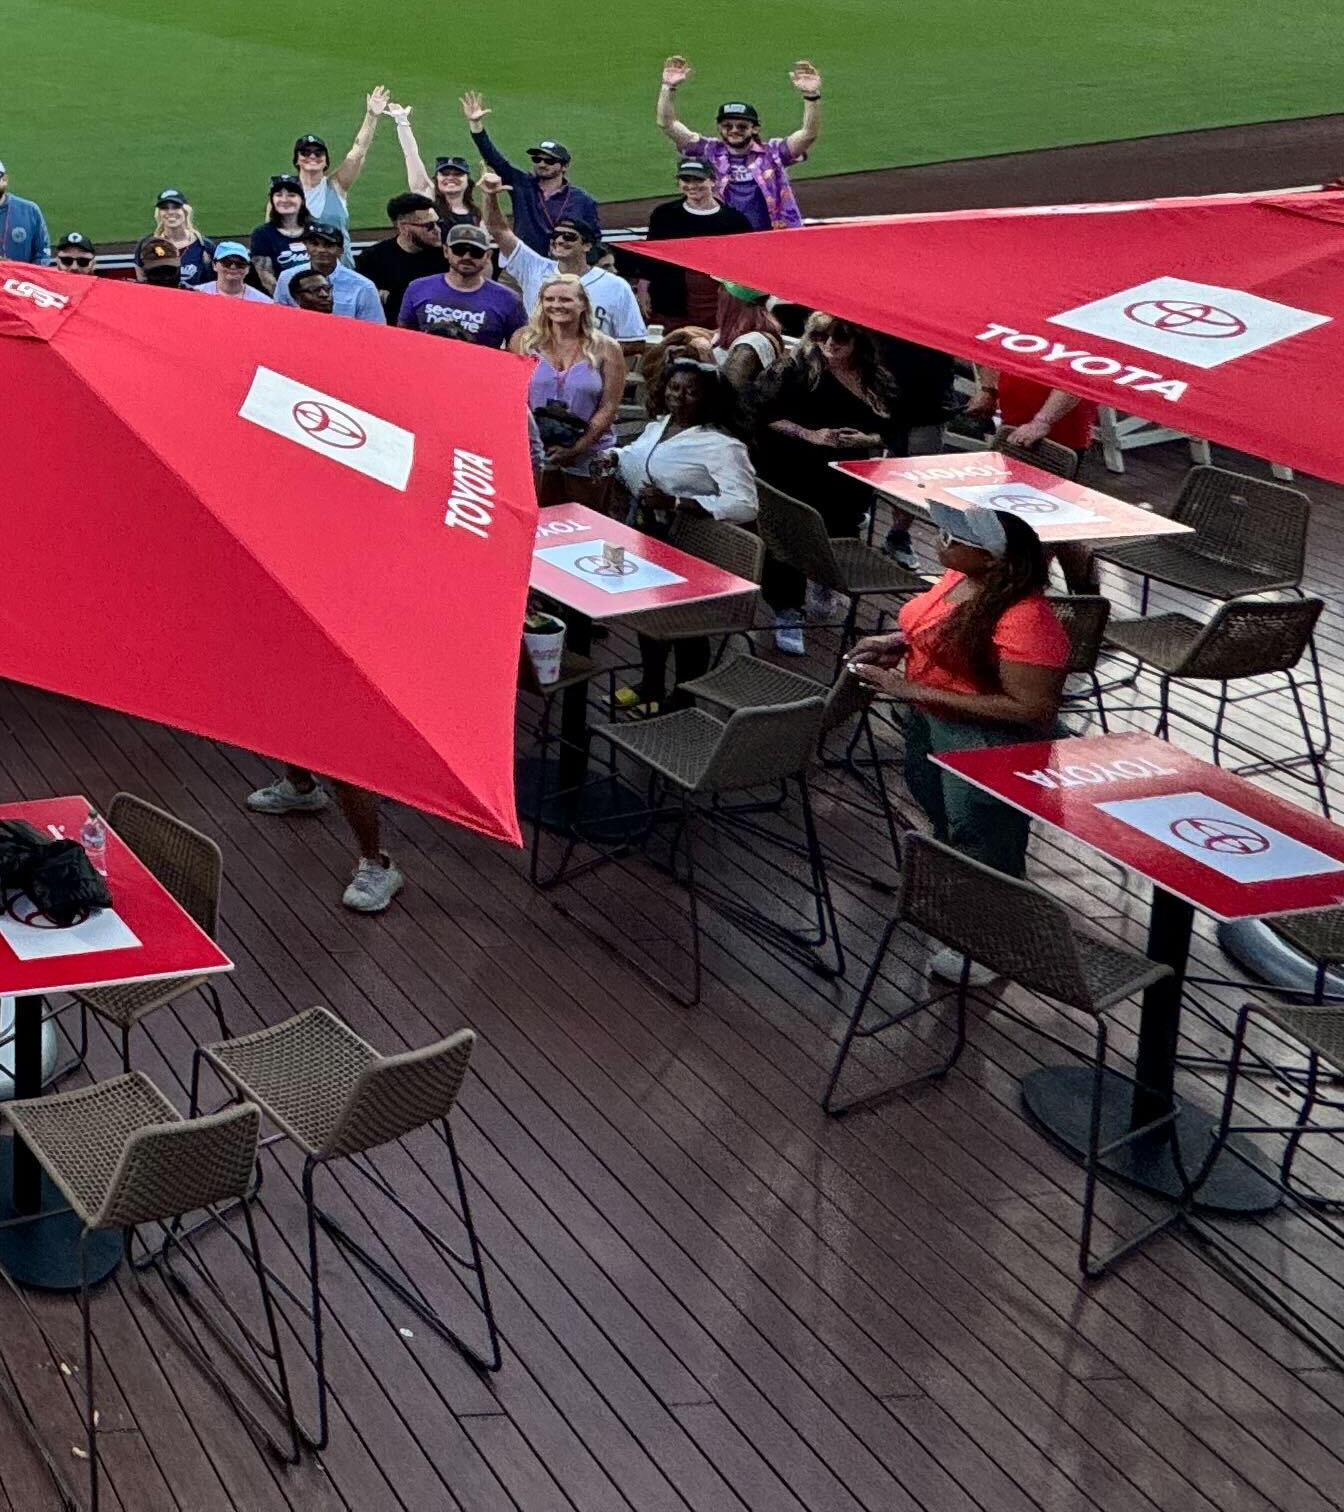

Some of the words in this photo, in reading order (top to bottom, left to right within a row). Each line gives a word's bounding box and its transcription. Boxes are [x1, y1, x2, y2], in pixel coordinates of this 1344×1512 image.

[424, 303, 486, 325] second
[975, 323, 1189, 402] TOYOTA
[444, 448, 497, 539] TOYOTA
[1012, 756, 1180, 790] TOYOTA
